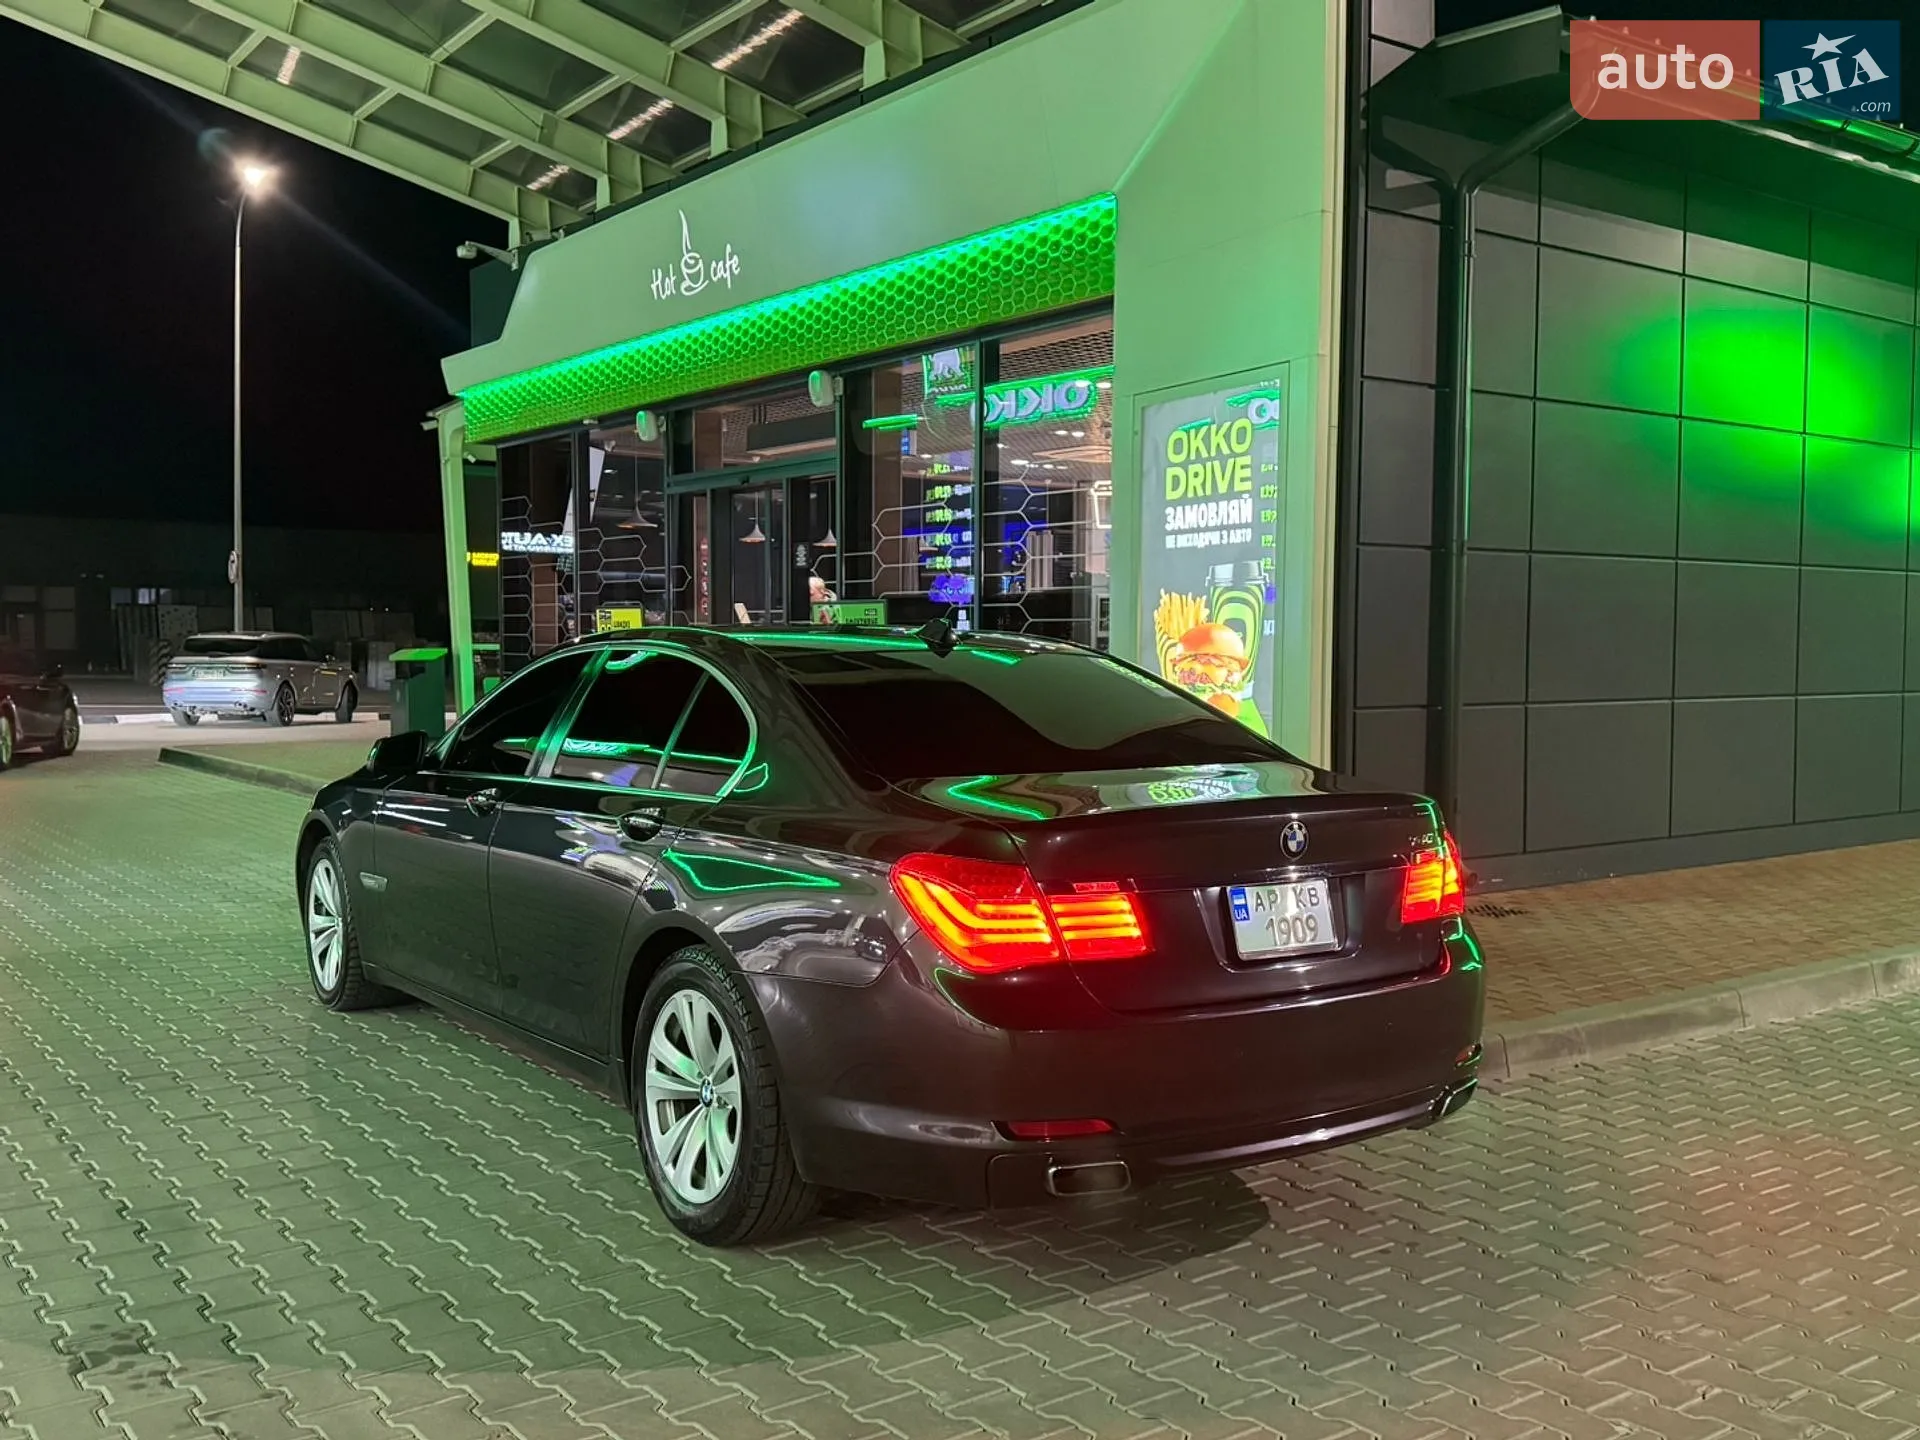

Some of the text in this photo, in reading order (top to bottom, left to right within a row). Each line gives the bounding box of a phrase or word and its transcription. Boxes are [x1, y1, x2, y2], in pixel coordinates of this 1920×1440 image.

[651, 243, 741, 300] Hot cafe
[1167, 418, 1252, 464] OKKO
[1165, 455, 1252, 500] DRIVE
[1164, 493, 1253, 531] ЗАМОВЛЯЙ
[1234, 886, 1320, 920] UA AP KB
[1265, 914, 1318, 947] 1909
